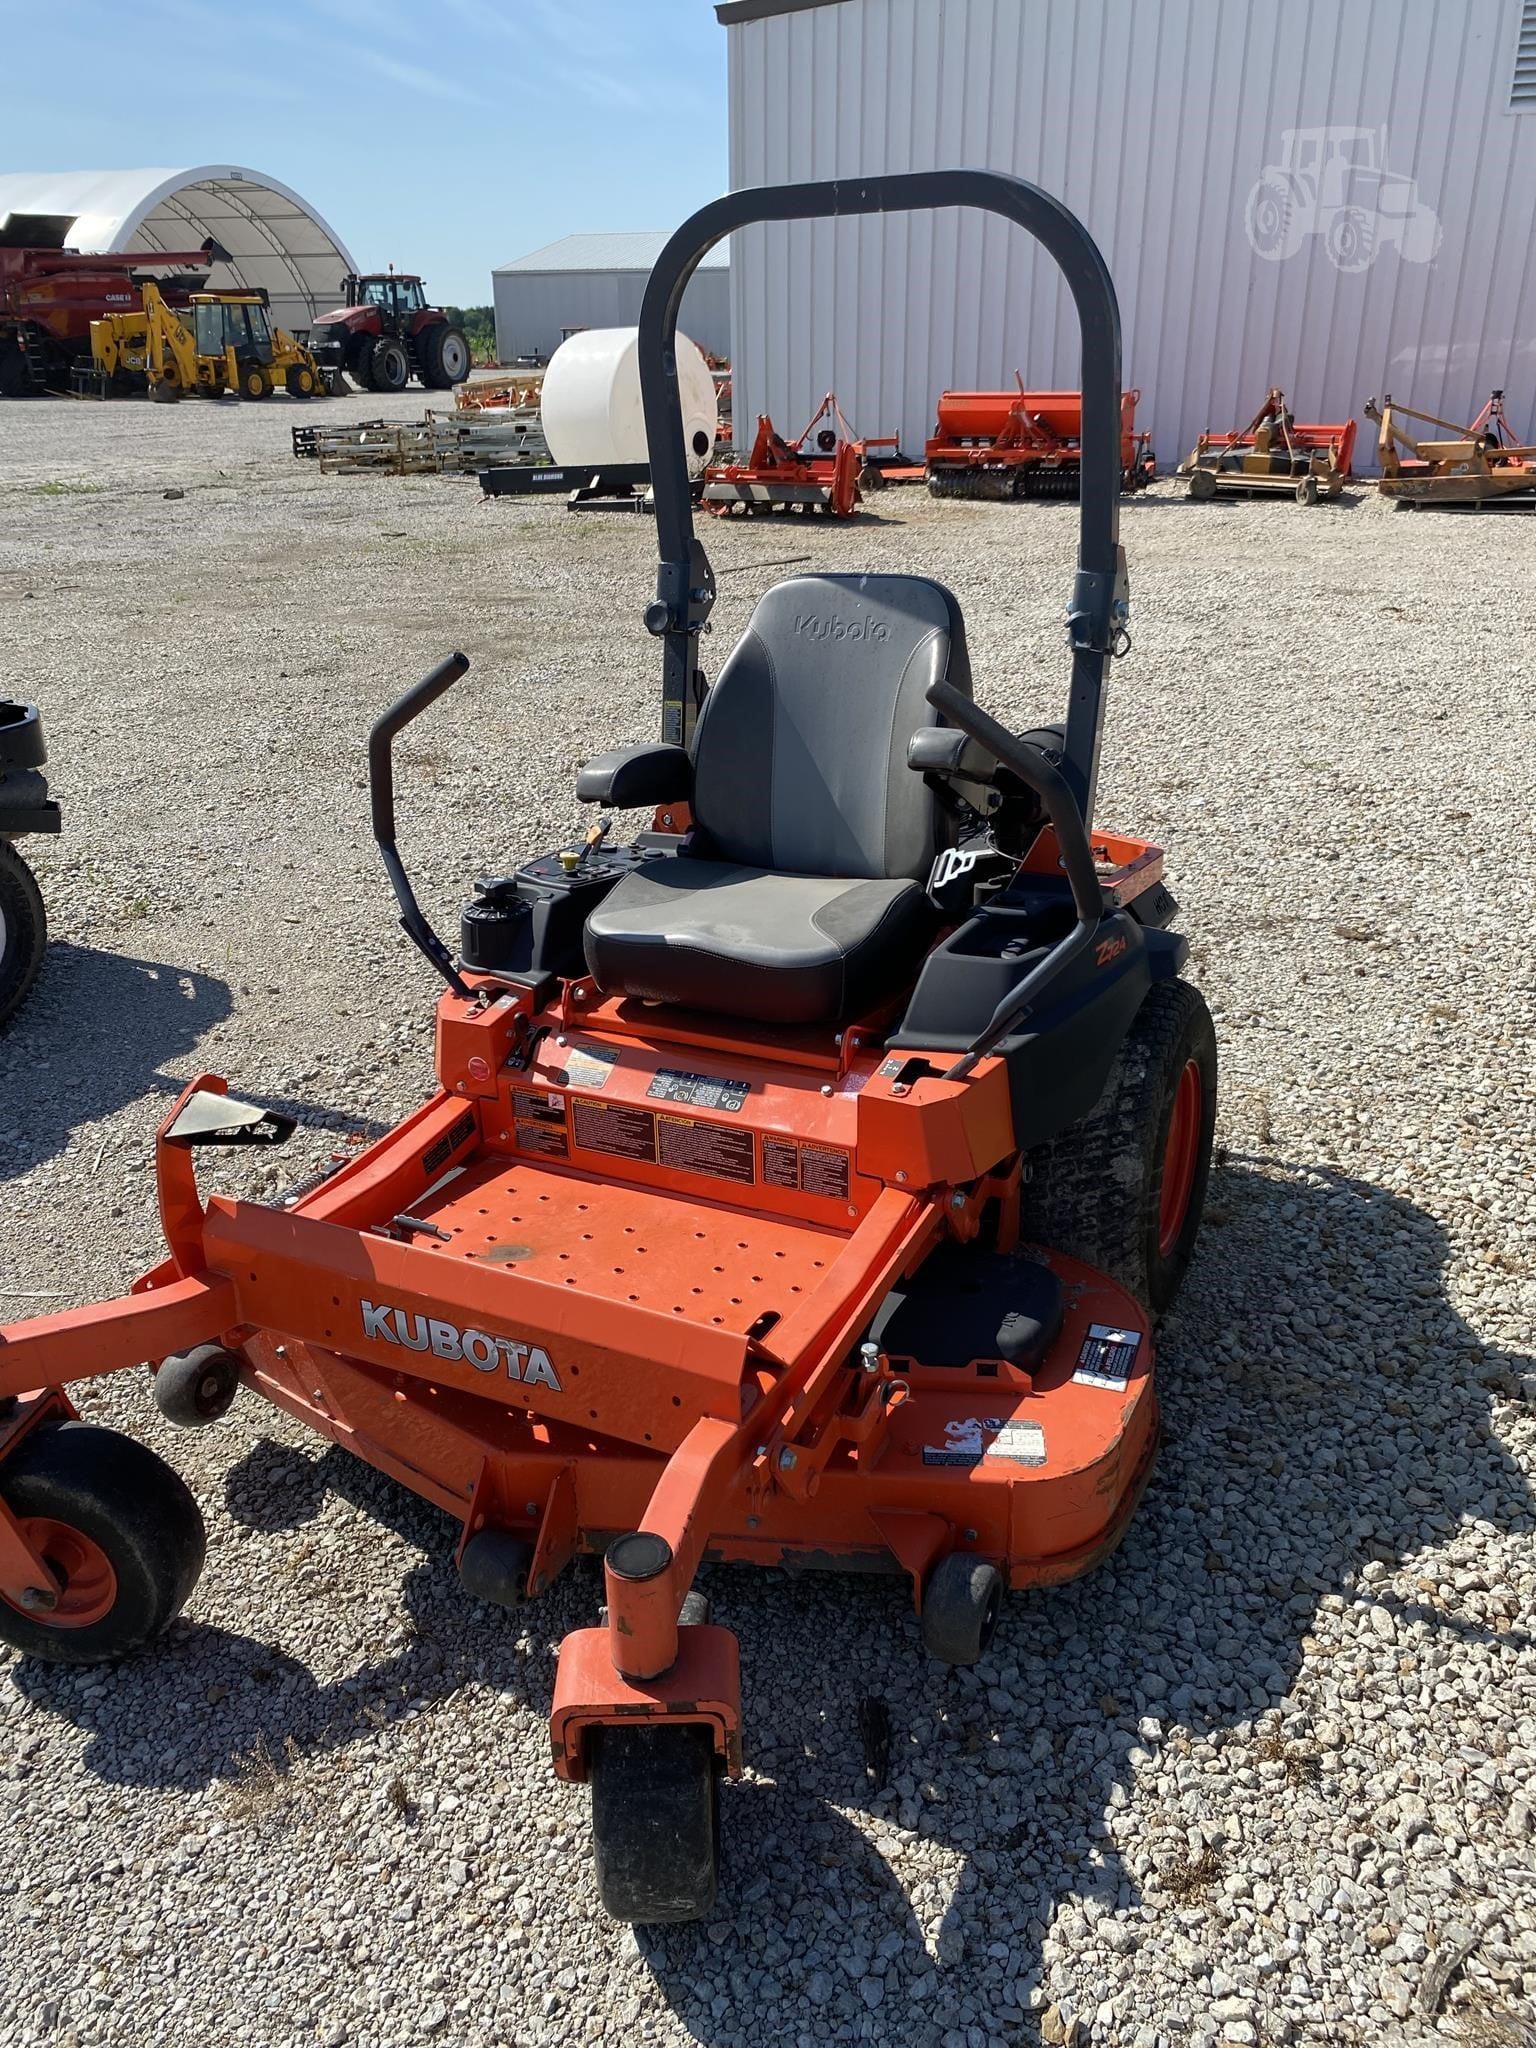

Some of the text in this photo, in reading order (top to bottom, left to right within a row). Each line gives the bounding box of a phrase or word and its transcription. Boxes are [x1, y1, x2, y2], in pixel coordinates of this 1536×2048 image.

[126, 356, 141, 365] JCB
[794, 614, 893, 642] Kubota
[579, 1099, 602, 1108] CAUTION
[359, 1298, 564, 1394] KUBOTA
